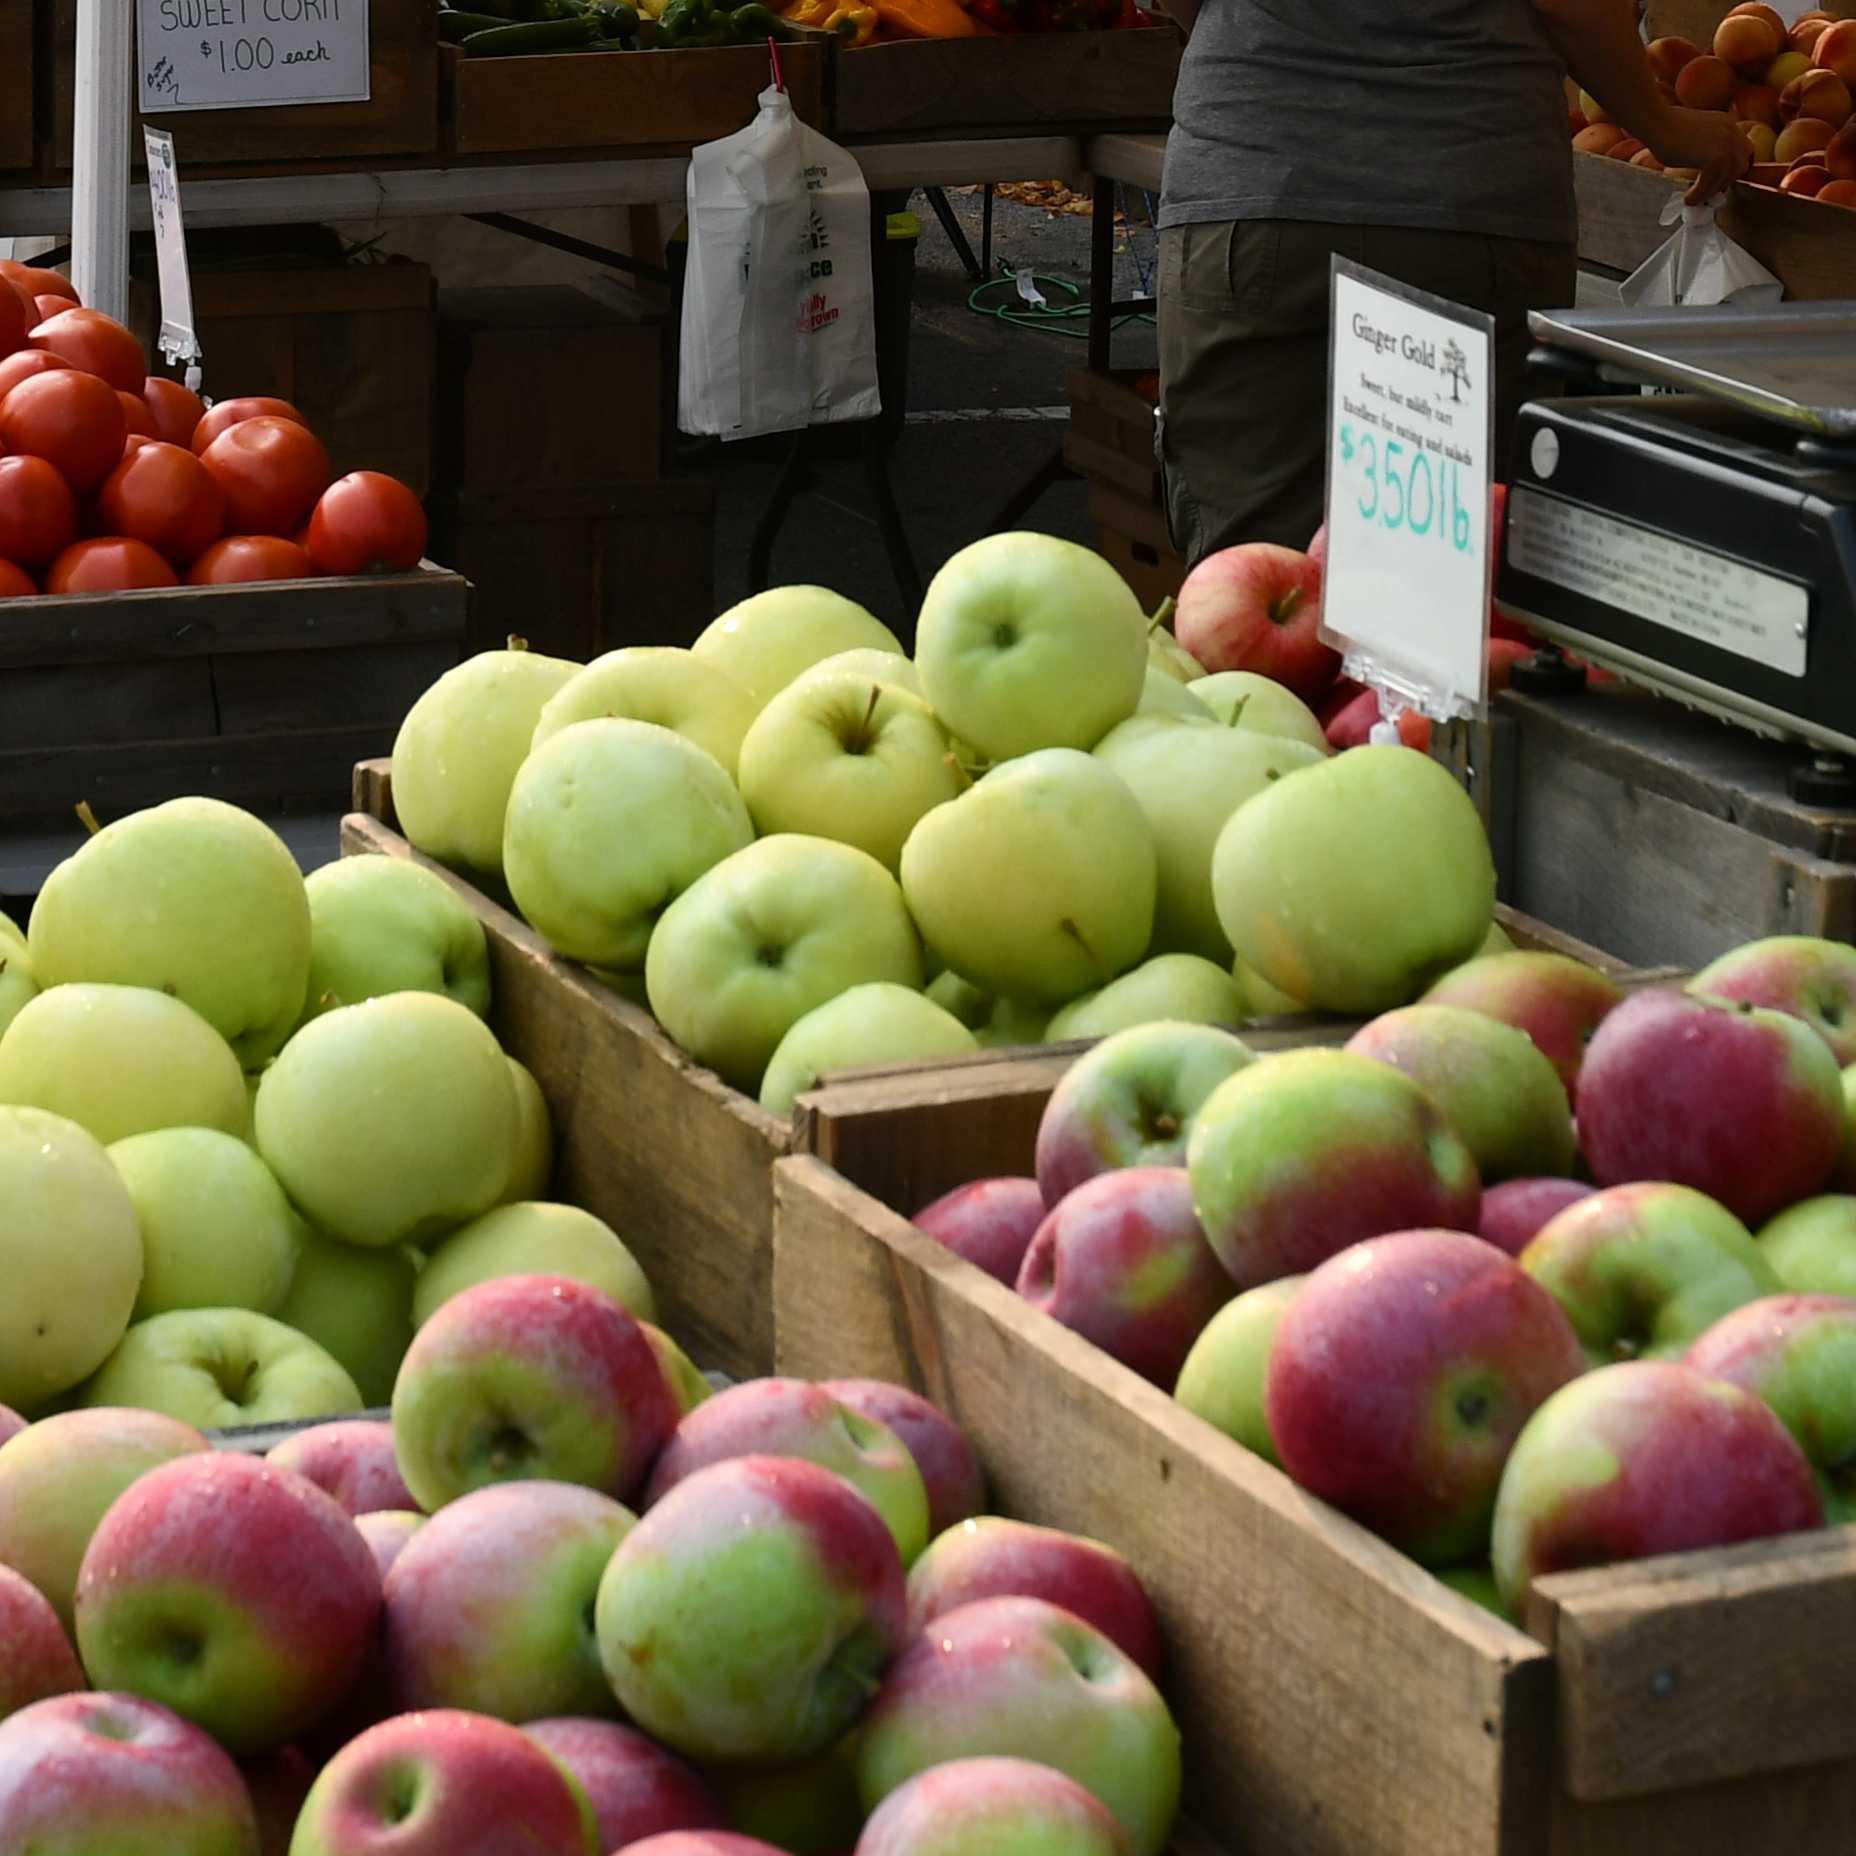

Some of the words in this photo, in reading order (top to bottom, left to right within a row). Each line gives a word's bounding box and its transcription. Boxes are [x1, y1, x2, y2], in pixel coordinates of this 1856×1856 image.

[200, 37, 275, 73] $1.00
[281, 40, 332, 64] each
[1353, 312, 1397, 355] Ginger
[1401, 334, 1436, 370] Gold
